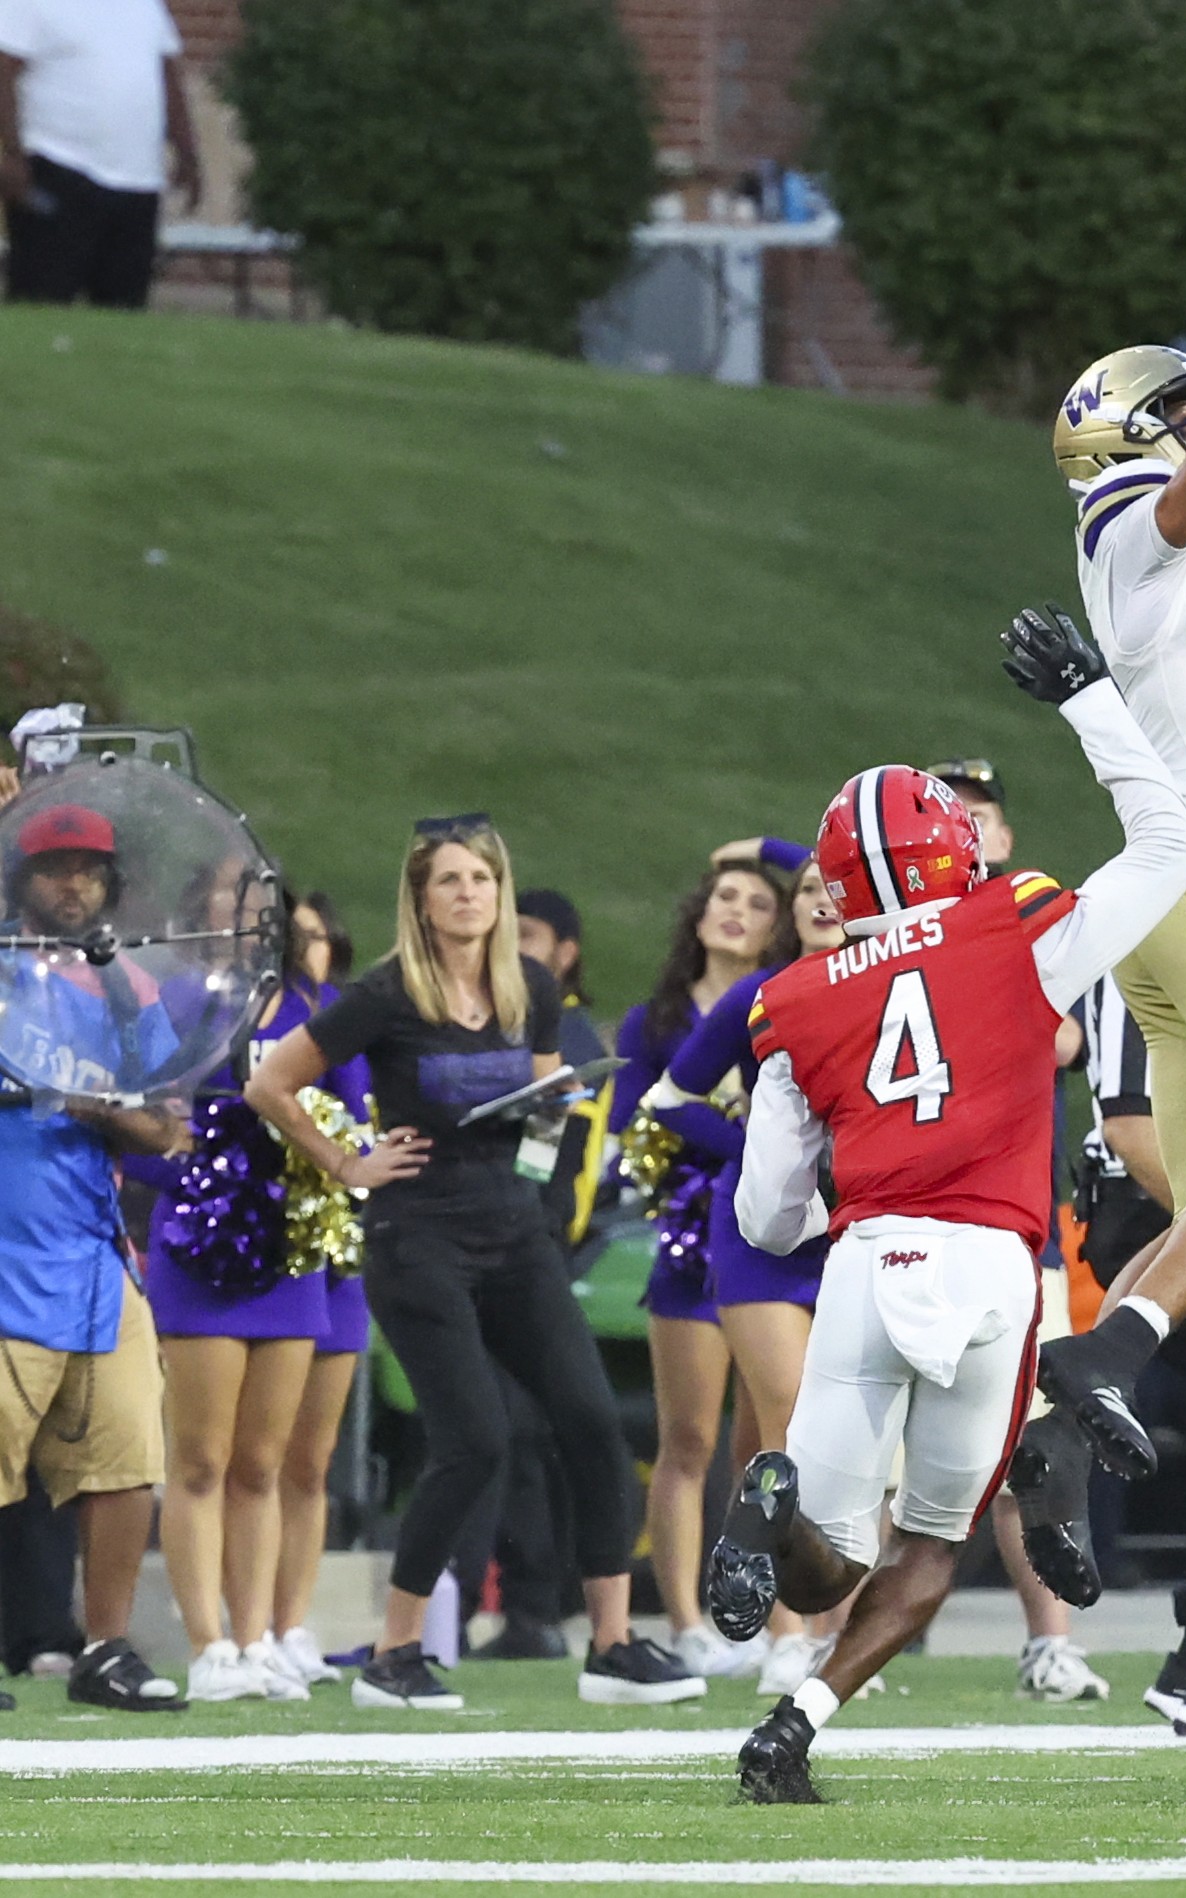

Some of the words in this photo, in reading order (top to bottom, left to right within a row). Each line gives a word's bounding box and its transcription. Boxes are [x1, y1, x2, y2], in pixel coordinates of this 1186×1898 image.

[1062, 367, 1109, 430] W
[826, 912, 944, 985] HUMES
[864, 967, 954, 1126] 4
